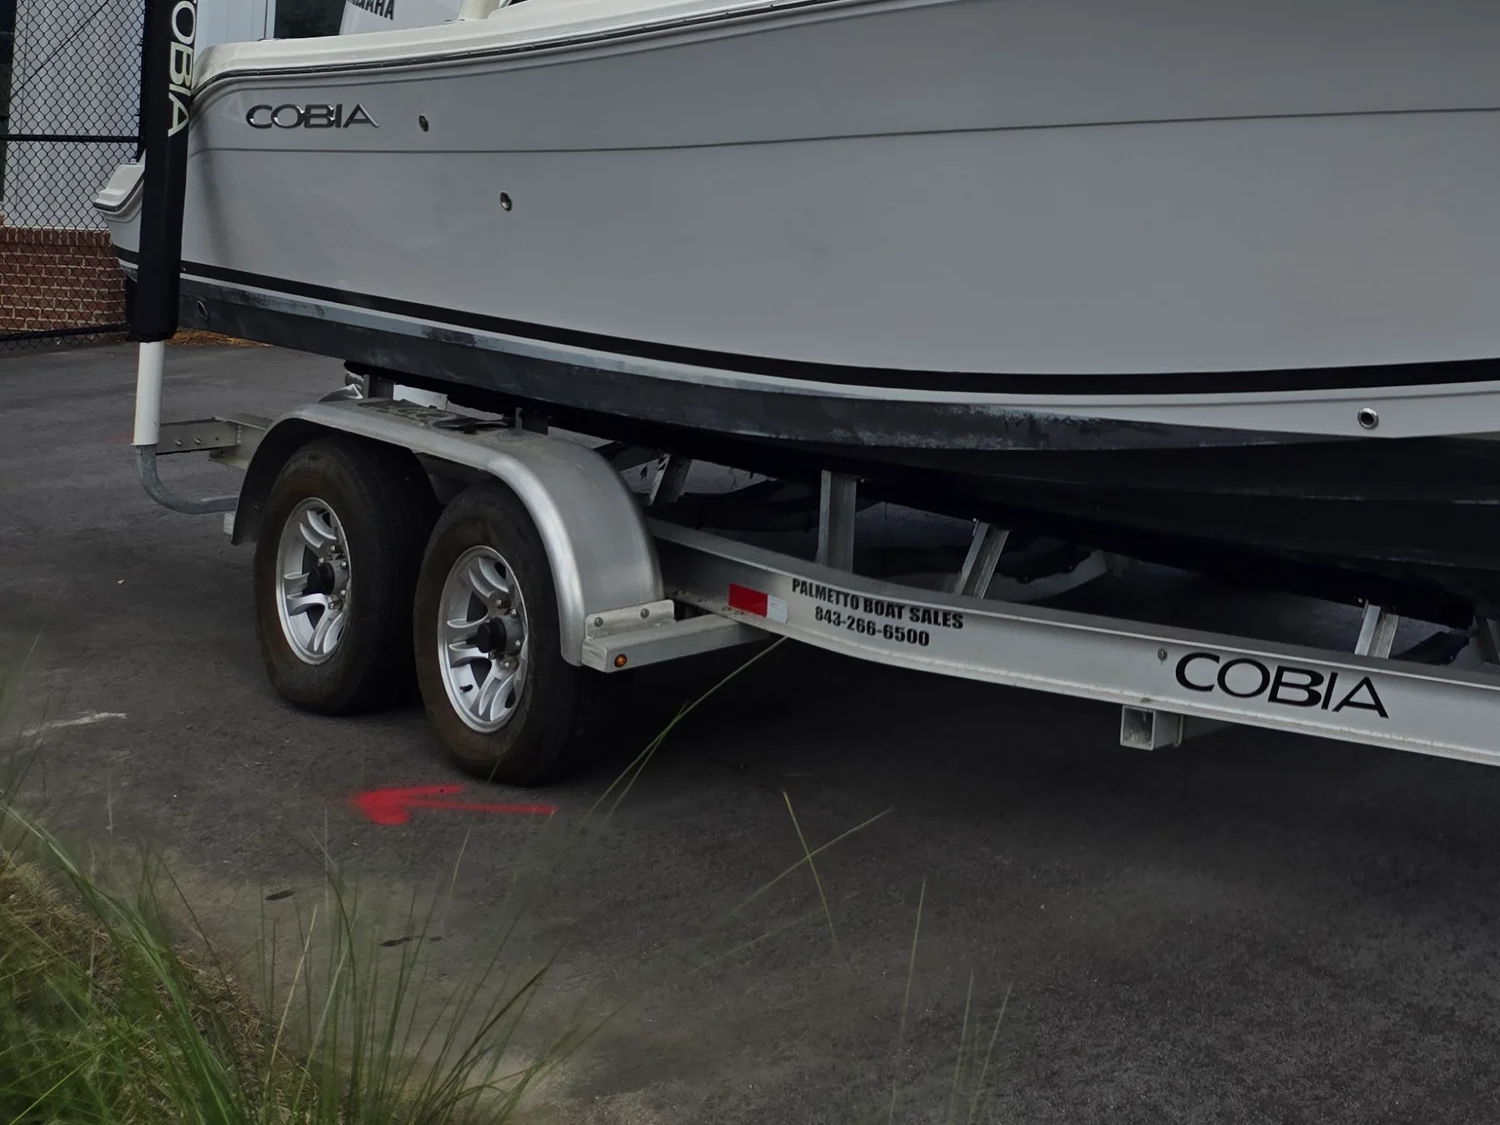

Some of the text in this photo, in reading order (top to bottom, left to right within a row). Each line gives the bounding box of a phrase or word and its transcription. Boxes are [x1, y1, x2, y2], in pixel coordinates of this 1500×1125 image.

[246, 103, 380, 129] COBIA
[791, 577, 964, 630] PALMETTO BOAT SALES
[815, 605, 930, 647] 843-266-6500
[1175, 652, 1389, 719] COBIA
